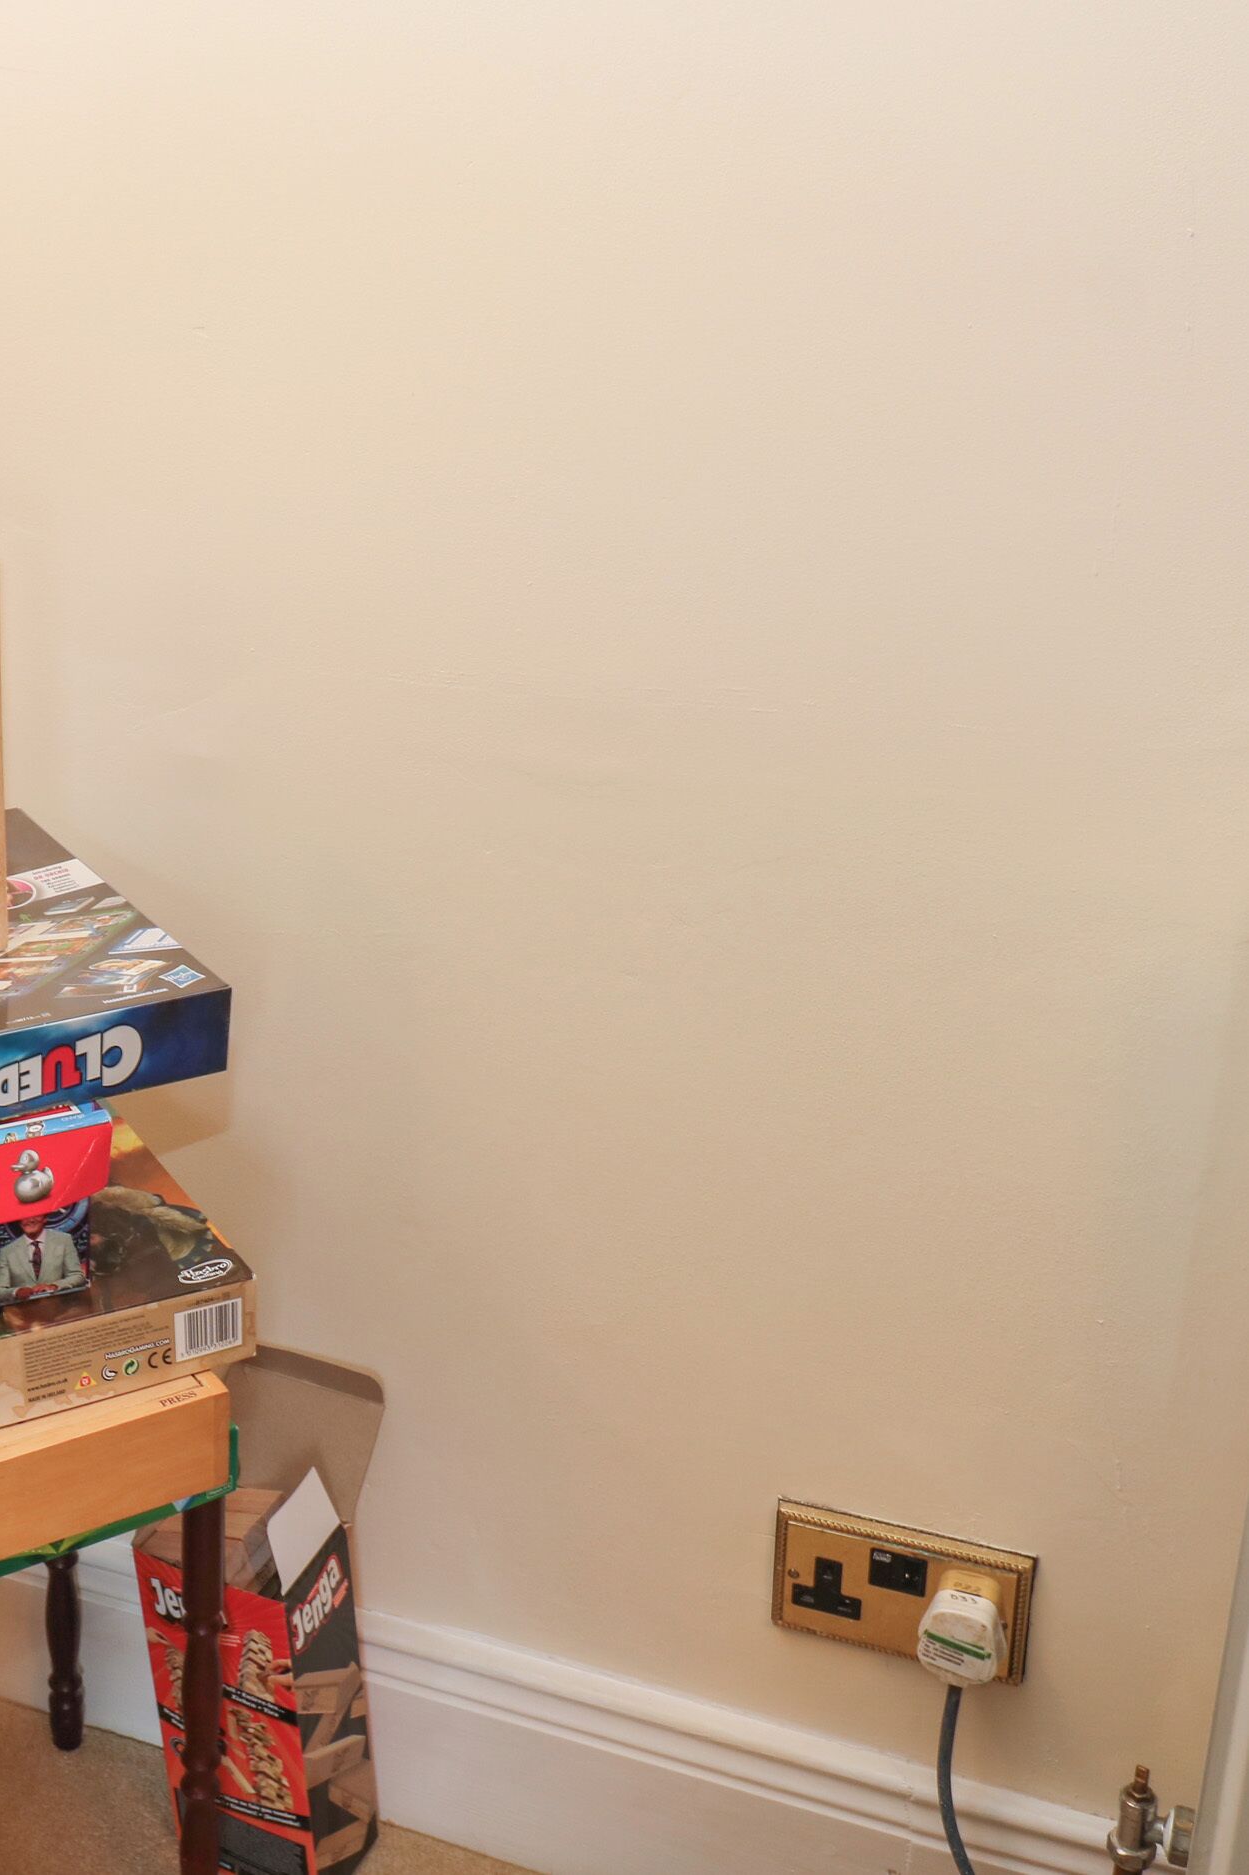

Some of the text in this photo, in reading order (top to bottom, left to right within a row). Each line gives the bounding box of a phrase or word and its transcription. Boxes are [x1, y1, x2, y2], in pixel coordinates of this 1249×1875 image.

[181, 1262, 227, 1278] Hasbro
[159, 1390, 197, 1407] PRESS
[292, 1557, 341, 1650] Jenga
